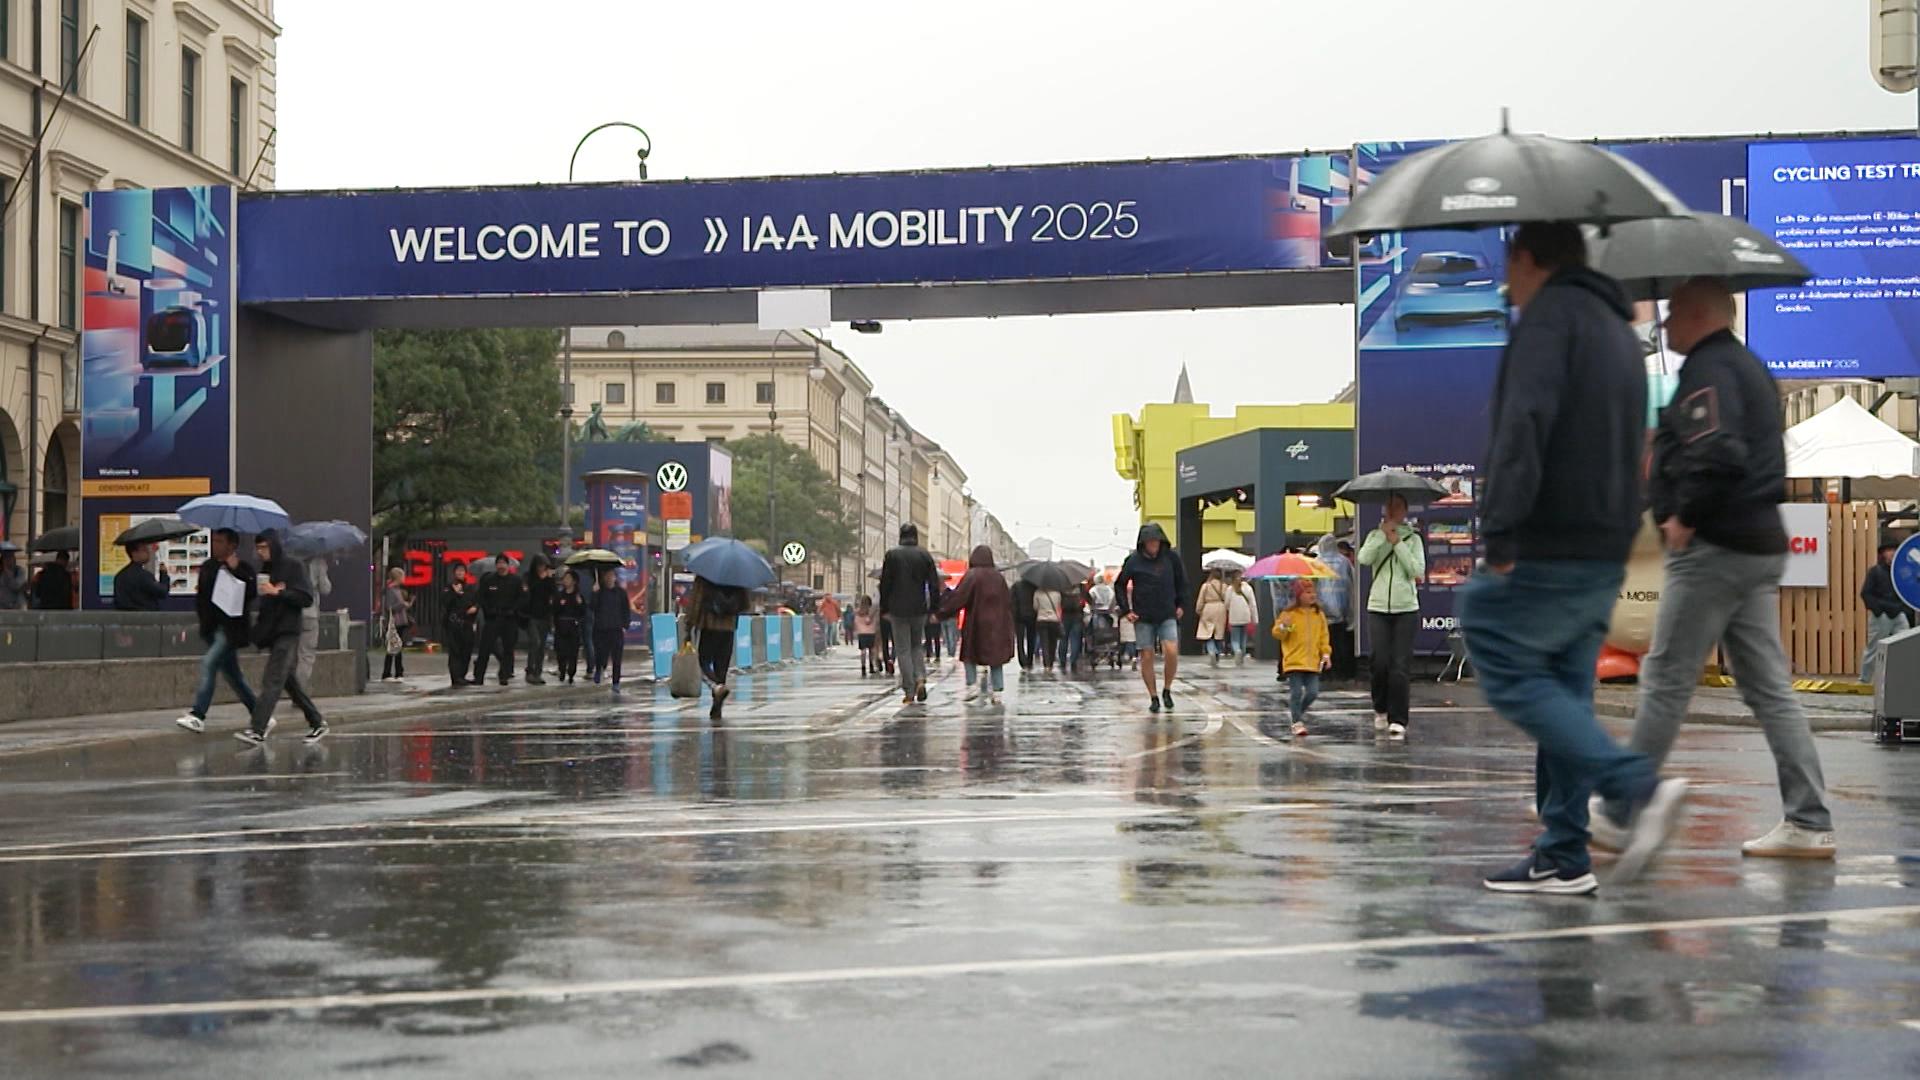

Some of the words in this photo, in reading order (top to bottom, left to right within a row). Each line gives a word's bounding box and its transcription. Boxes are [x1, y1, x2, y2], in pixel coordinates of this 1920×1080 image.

[1772, 165, 1850, 183] CYCLING
[1855, 164, 1897, 180] TEST
[389, 222, 601, 263] WELCOME
[613, 219, 671, 257] TO
[742, 214, 819, 252] IAA
[829, 205, 1025, 249] MOBILITY
[1030, 201, 1140, 242] 2025
